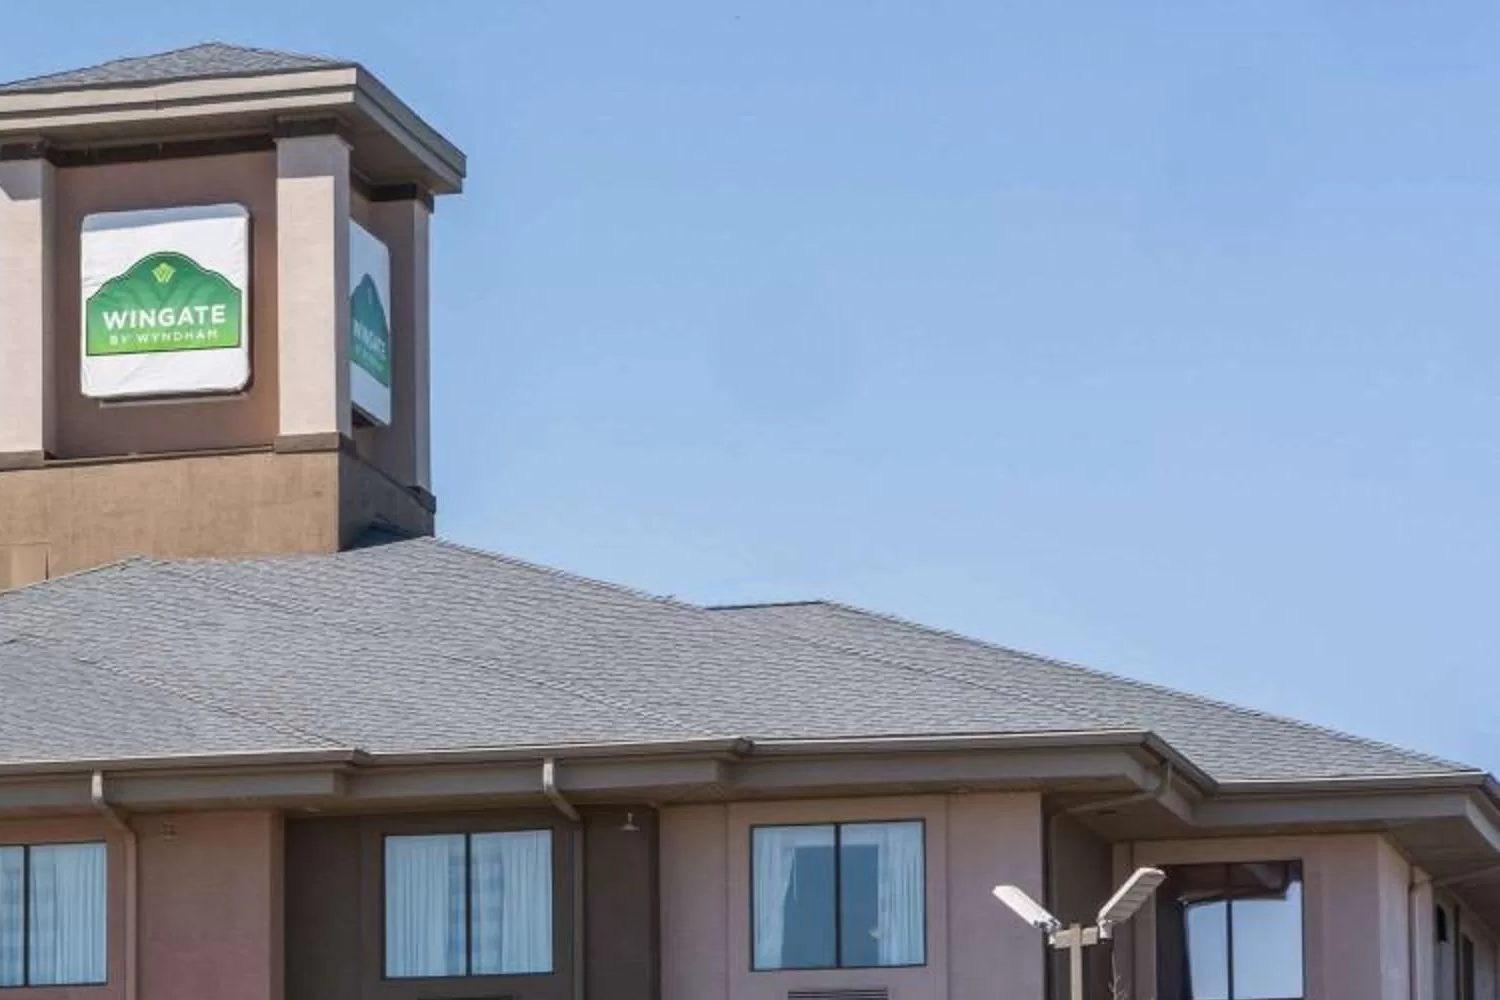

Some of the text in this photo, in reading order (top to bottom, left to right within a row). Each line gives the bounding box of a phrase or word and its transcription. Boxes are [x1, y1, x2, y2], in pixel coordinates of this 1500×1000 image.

[102, 304, 226, 330] WINGATE
[109, 330, 217, 346] BY WYNDHAM
